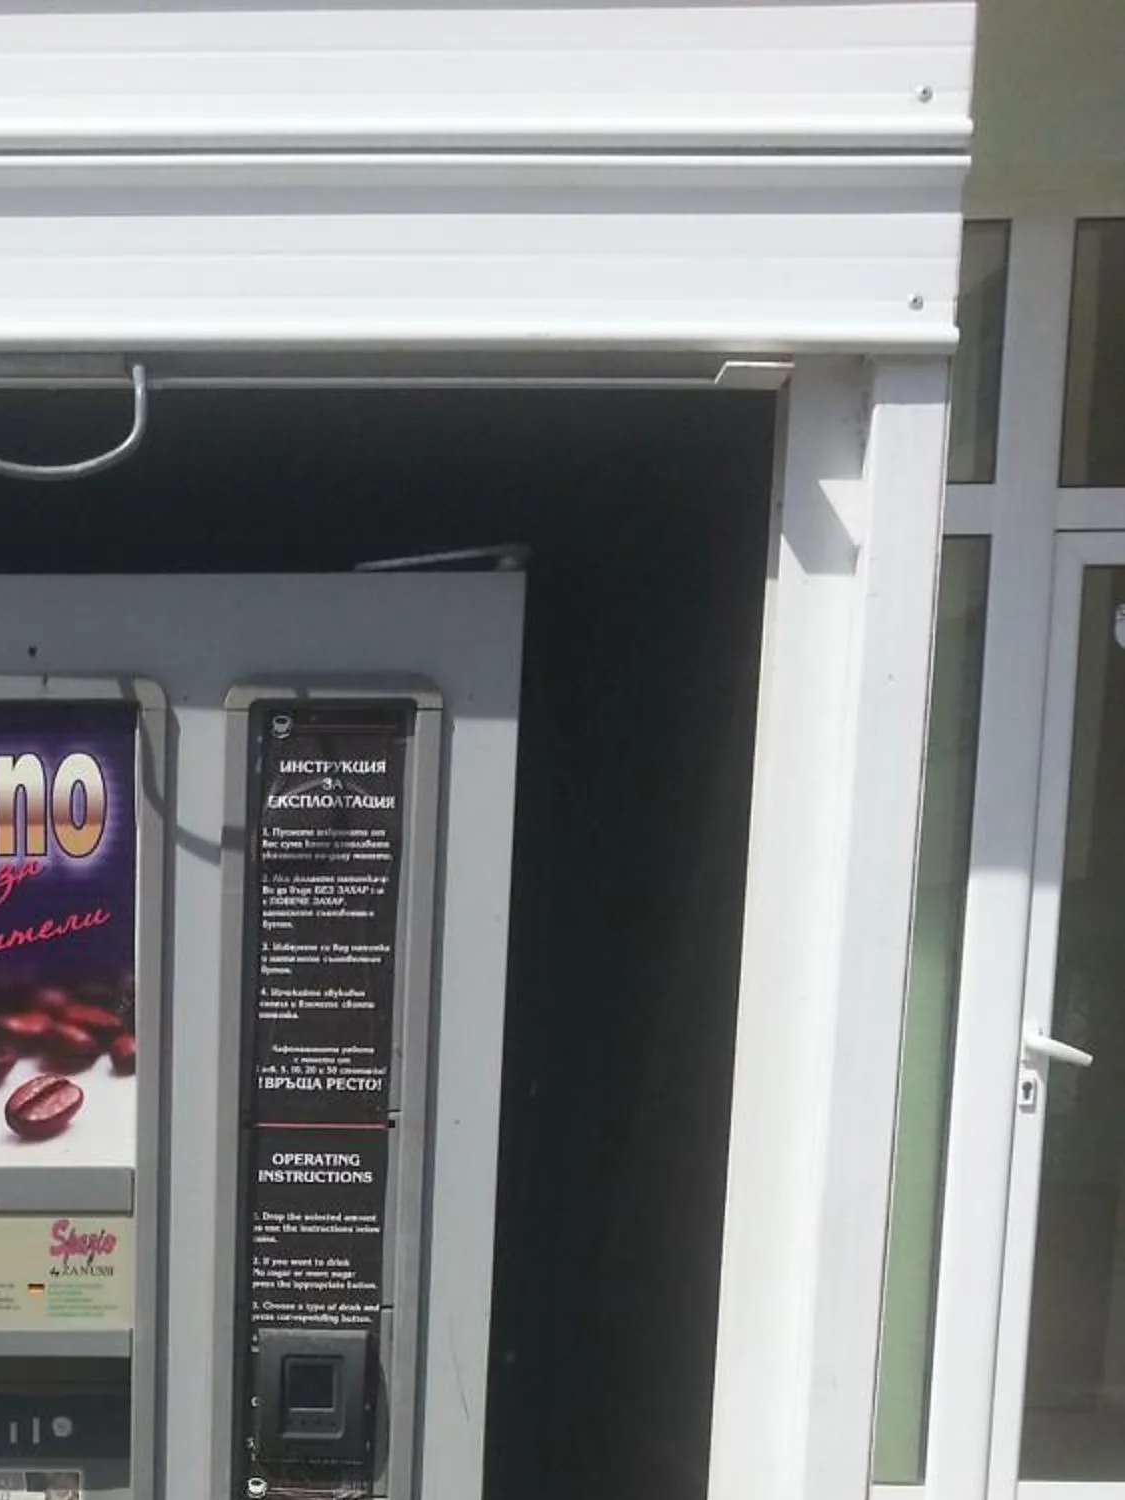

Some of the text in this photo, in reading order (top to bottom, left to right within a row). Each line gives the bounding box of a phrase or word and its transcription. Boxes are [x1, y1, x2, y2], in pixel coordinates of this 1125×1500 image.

[279, 760, 388, 773] ИНСТРУКЦИЯ
[322, 777, 344, 790] ЗА
[326, 1077, 382, 1090] РЕСТО!
[272, 1153, 360, 1166] OPERATING
[258, 1169, 373, 1183] INSTRUCTIONS
[262, 1211, 285, 1223] Drop
[286, 1211, 302, 1221] the
[282, 1224, 298, 1232] the
[272, 1258, 288, 1267] you
[290, 1257, 312, 1266] want
[315, 1257, 325, 1266] to
[62, 1265, 114, 1277] ZANUSSI
